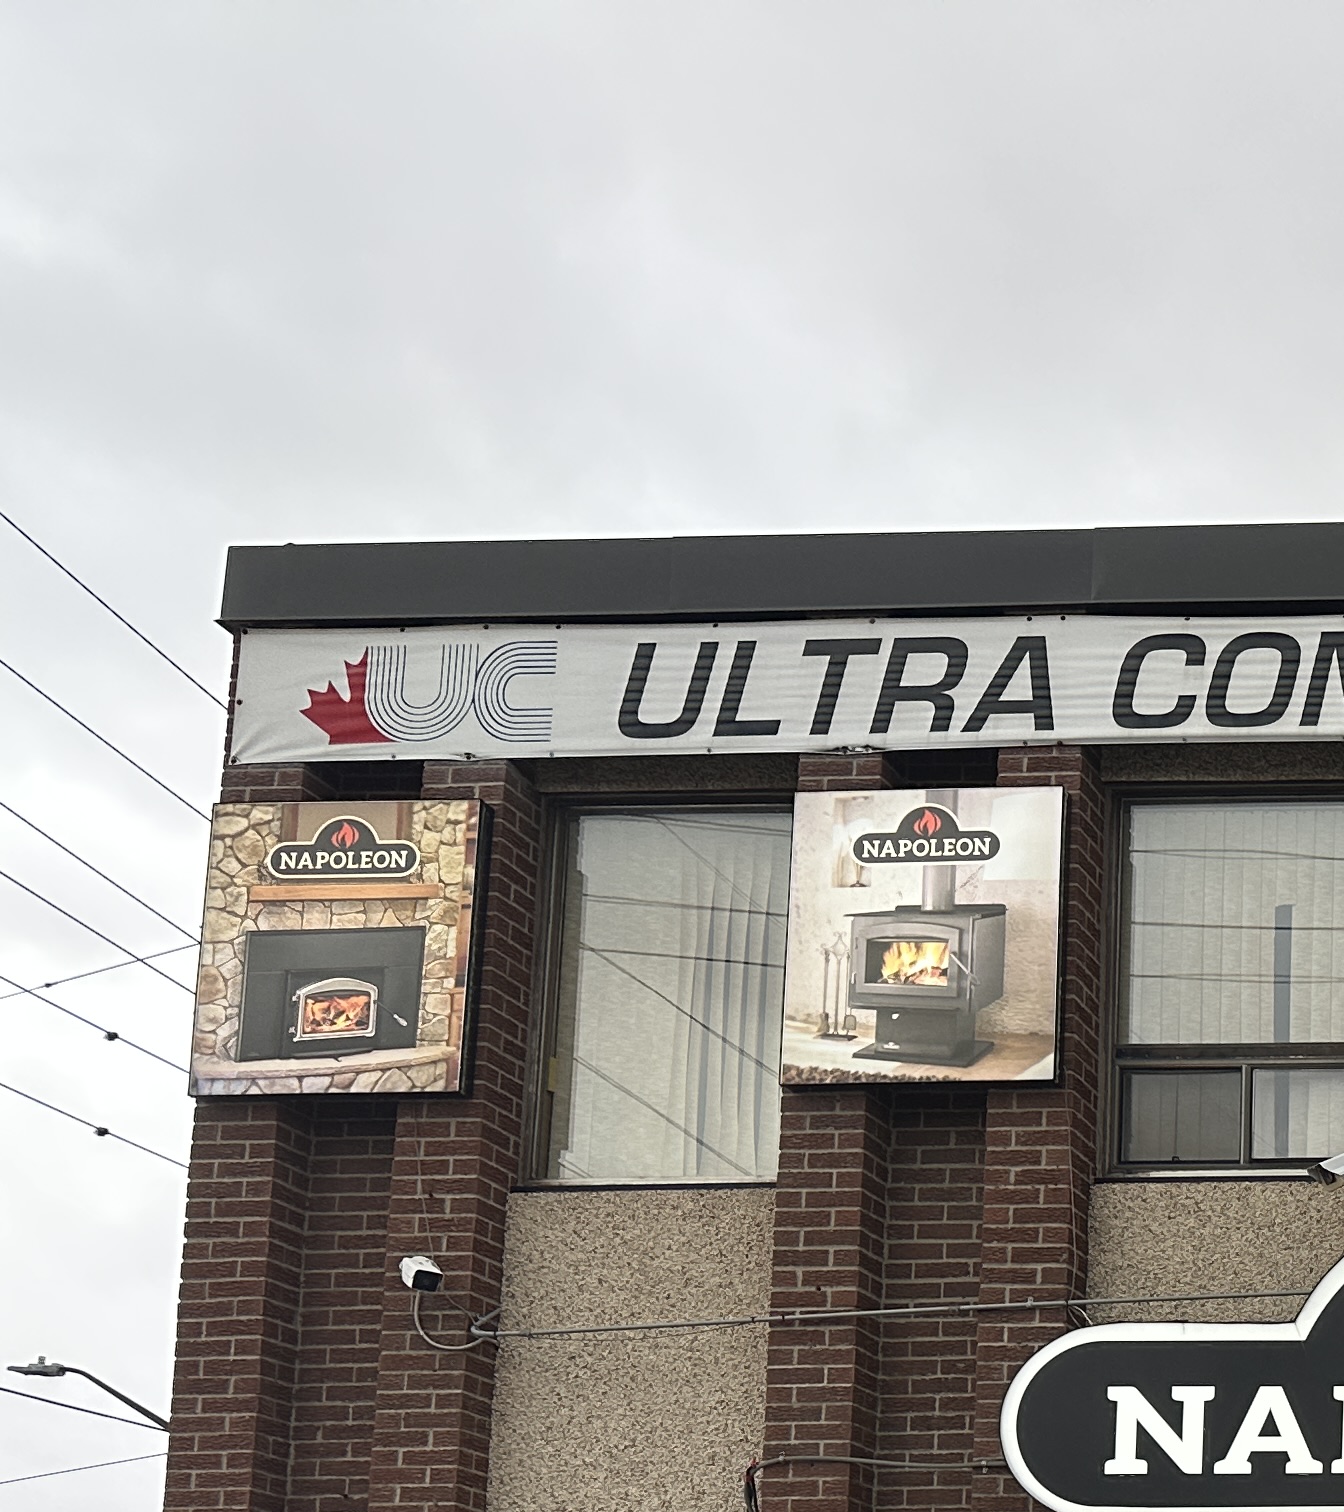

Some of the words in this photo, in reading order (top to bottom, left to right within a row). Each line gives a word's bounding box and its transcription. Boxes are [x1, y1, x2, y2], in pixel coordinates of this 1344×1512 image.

[618, 636, 1054, 740] ULTRA
[862, 838, 992, 858] NAPOLEON
[280, 851, 408, 870] NAPOLEON
